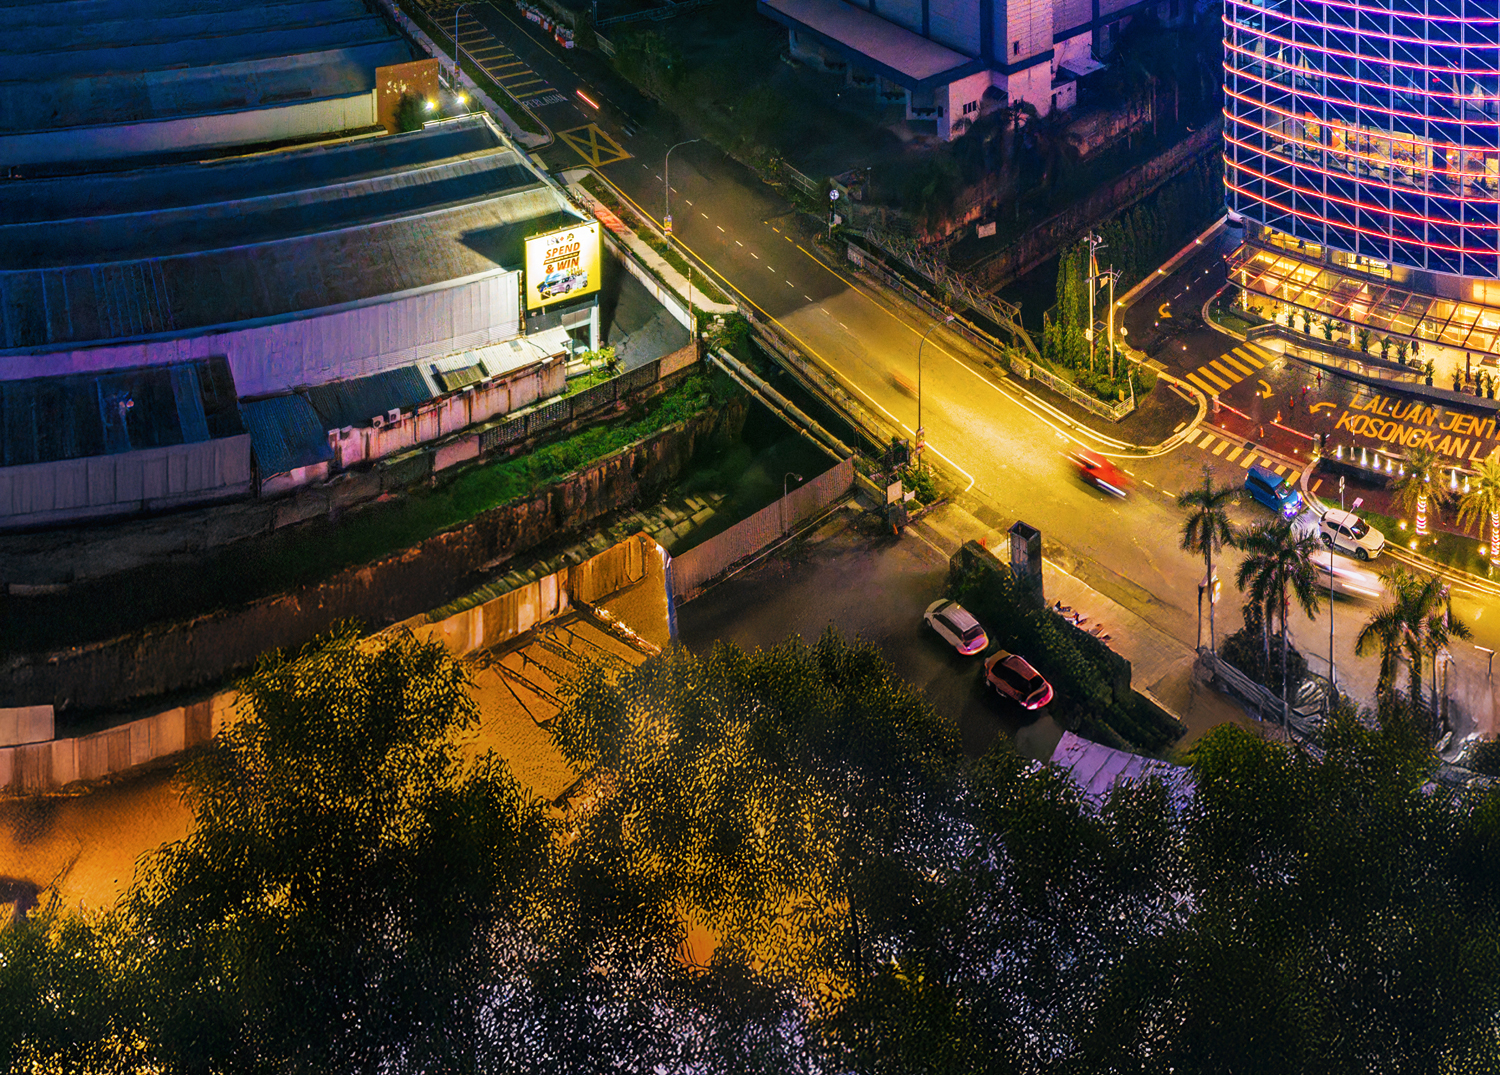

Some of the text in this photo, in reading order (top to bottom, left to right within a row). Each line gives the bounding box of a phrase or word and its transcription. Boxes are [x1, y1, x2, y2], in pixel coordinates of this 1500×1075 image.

[545, 242, 580, 259] SPEND
[545, 264, 554, 274] &
[557, 257, 579, 271] WIN
[1349, 391, 1439, 427] LALUAN
[1335, 410, 1471, 459] KOSONGKAN
